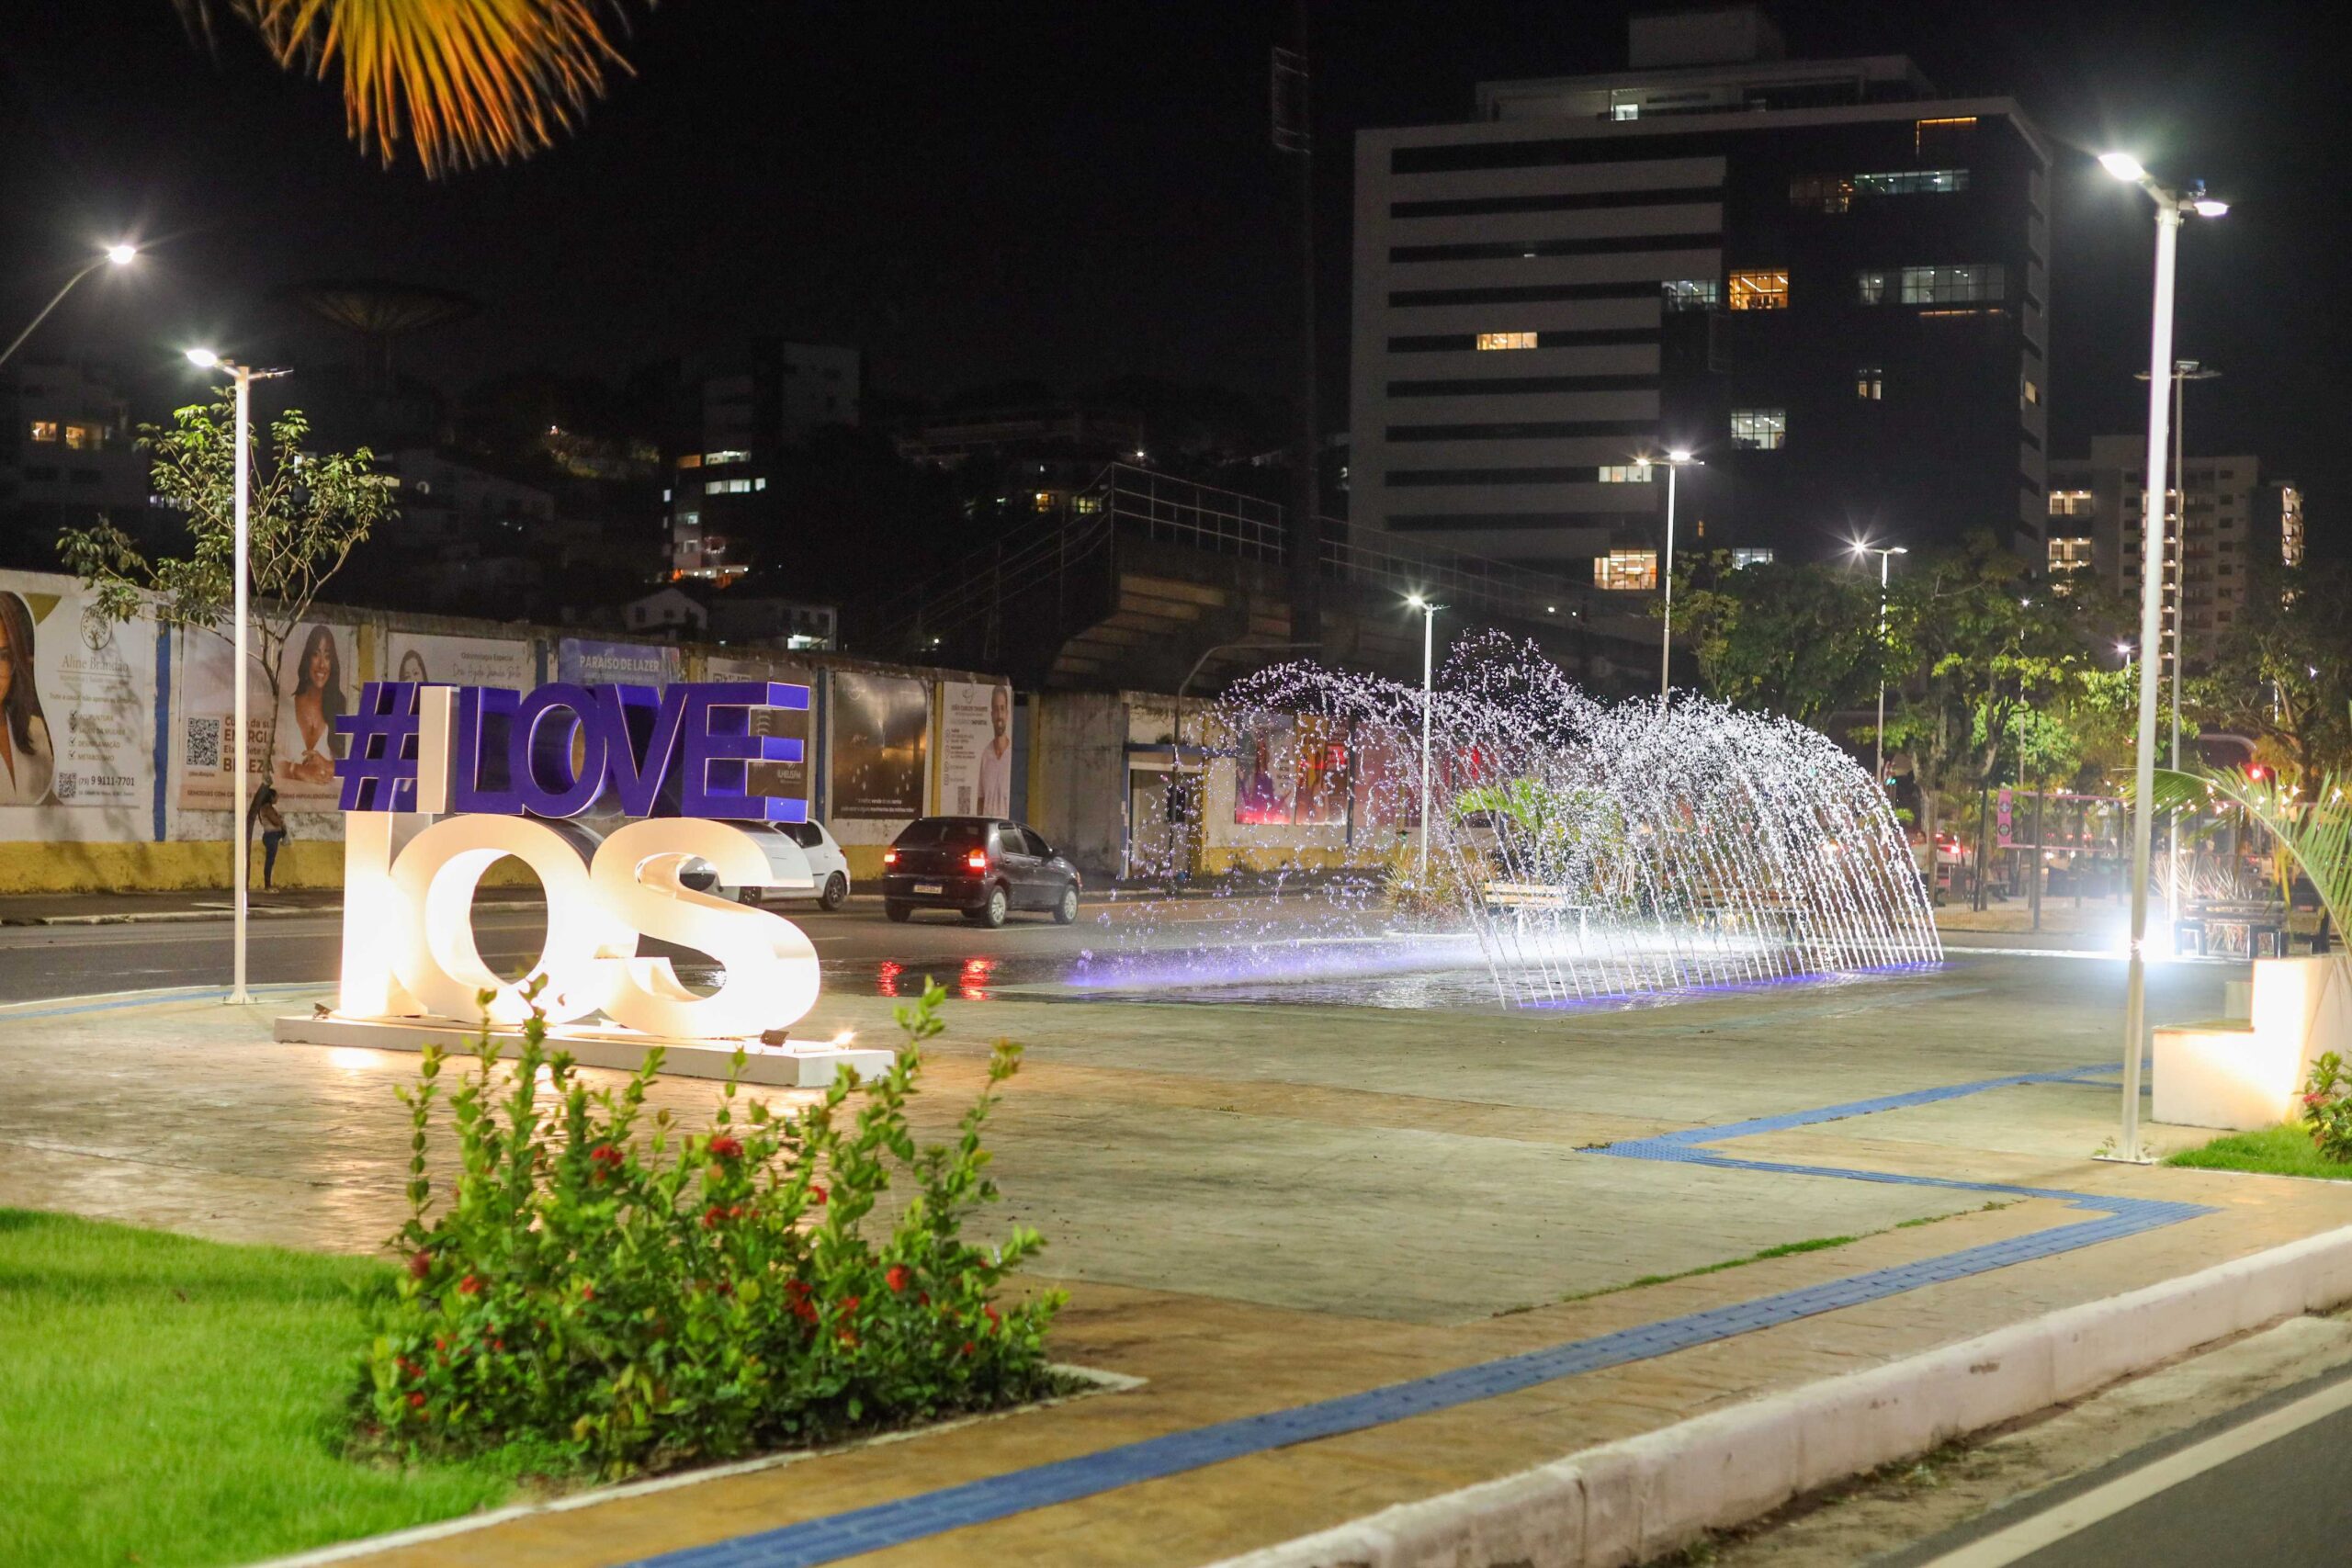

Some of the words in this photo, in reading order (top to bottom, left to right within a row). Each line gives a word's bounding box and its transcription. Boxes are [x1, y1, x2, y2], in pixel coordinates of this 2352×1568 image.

[62, 654, 87, 670] Aline
[580, 654, 618, 670] PARAÍSO
[620, 659, 632, 671] DE
[633, 660, 660, 672] LAZER
[250, 719, 260, 728] da
[91, 776, 96, 784] 9
[97, 776, 134, 786] 9111-7701
[340, 811, 820, 1039] IOS
